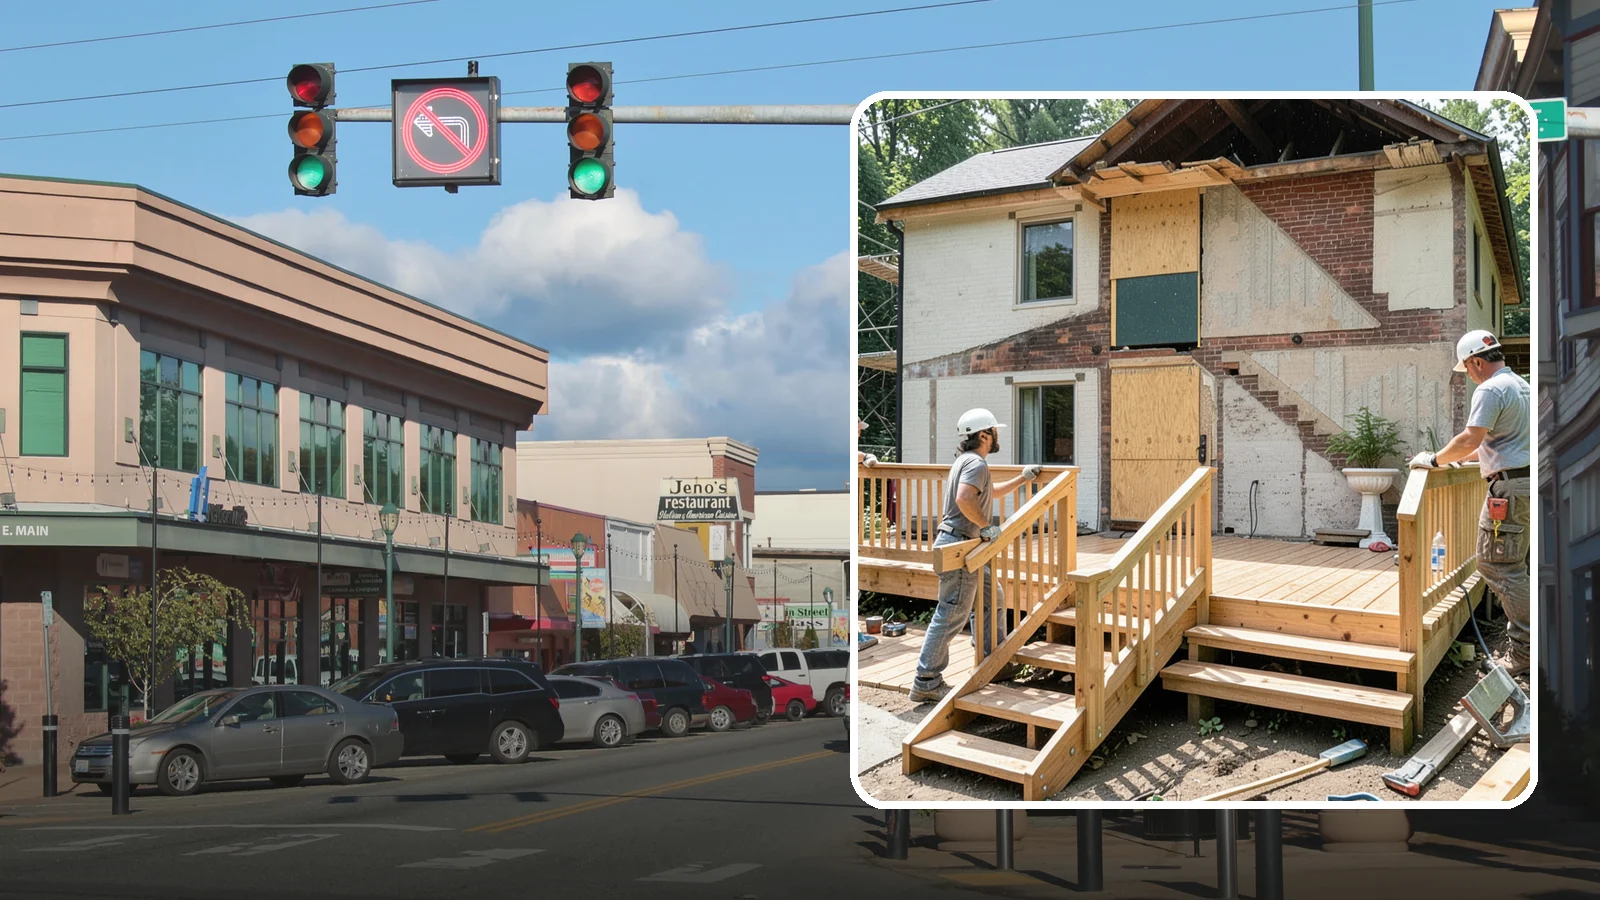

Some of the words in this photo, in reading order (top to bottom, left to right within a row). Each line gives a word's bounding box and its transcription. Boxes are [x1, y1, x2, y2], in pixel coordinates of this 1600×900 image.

[669, 480, 728, 495] Jeno's
[665, 496, 731, 509] restaurant
[659, 510, 681, 519] Italian
[686, 510, 715, 519] American
[715, 509, 738, 519] Cuisine
[2, 525, 13, 536] E.
[15, 525, 49, 537] MAIN
[797, 607, 829, 617] Street
